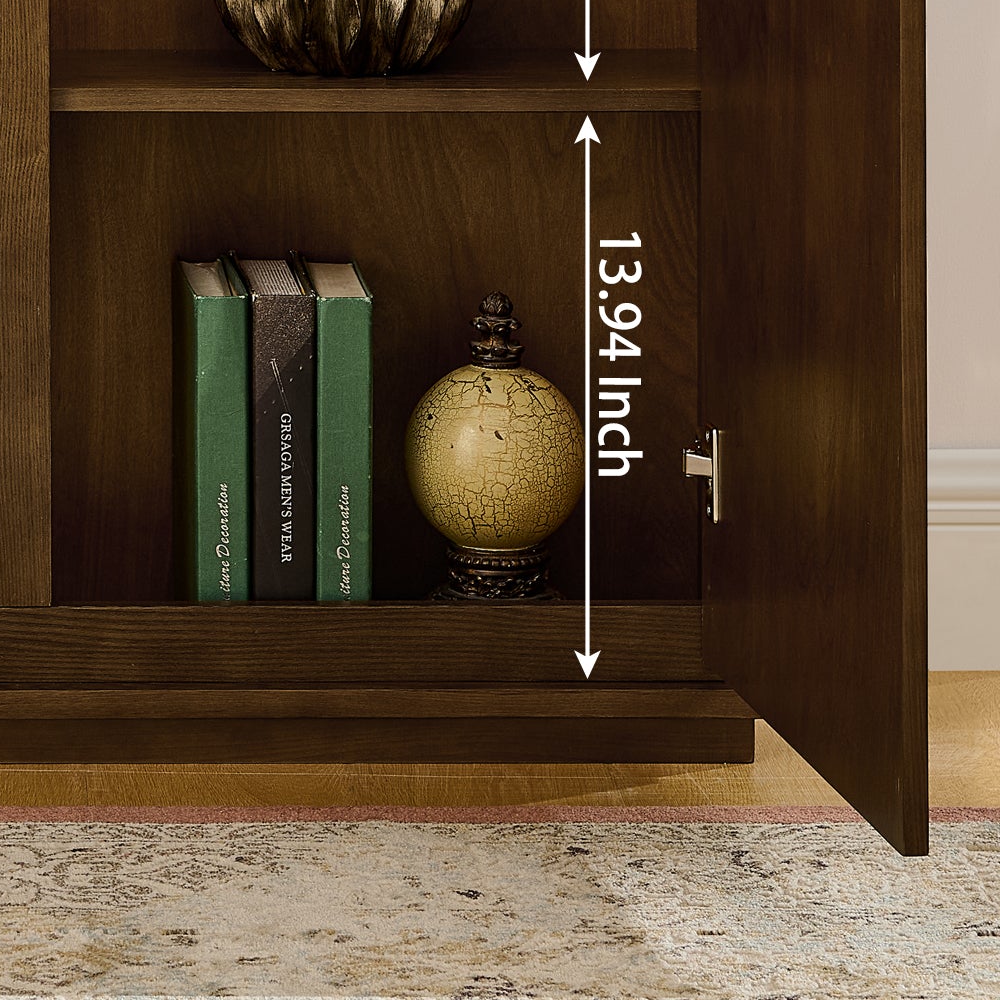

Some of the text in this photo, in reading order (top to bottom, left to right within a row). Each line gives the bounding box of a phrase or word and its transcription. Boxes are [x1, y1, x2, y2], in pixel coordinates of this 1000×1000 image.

[216, 483, 231, 601] iture Decoration
[280, 413, 292, 563] GRSAGA MEN'S WEAR
[336, 484, 351, 600] iture Decoration
